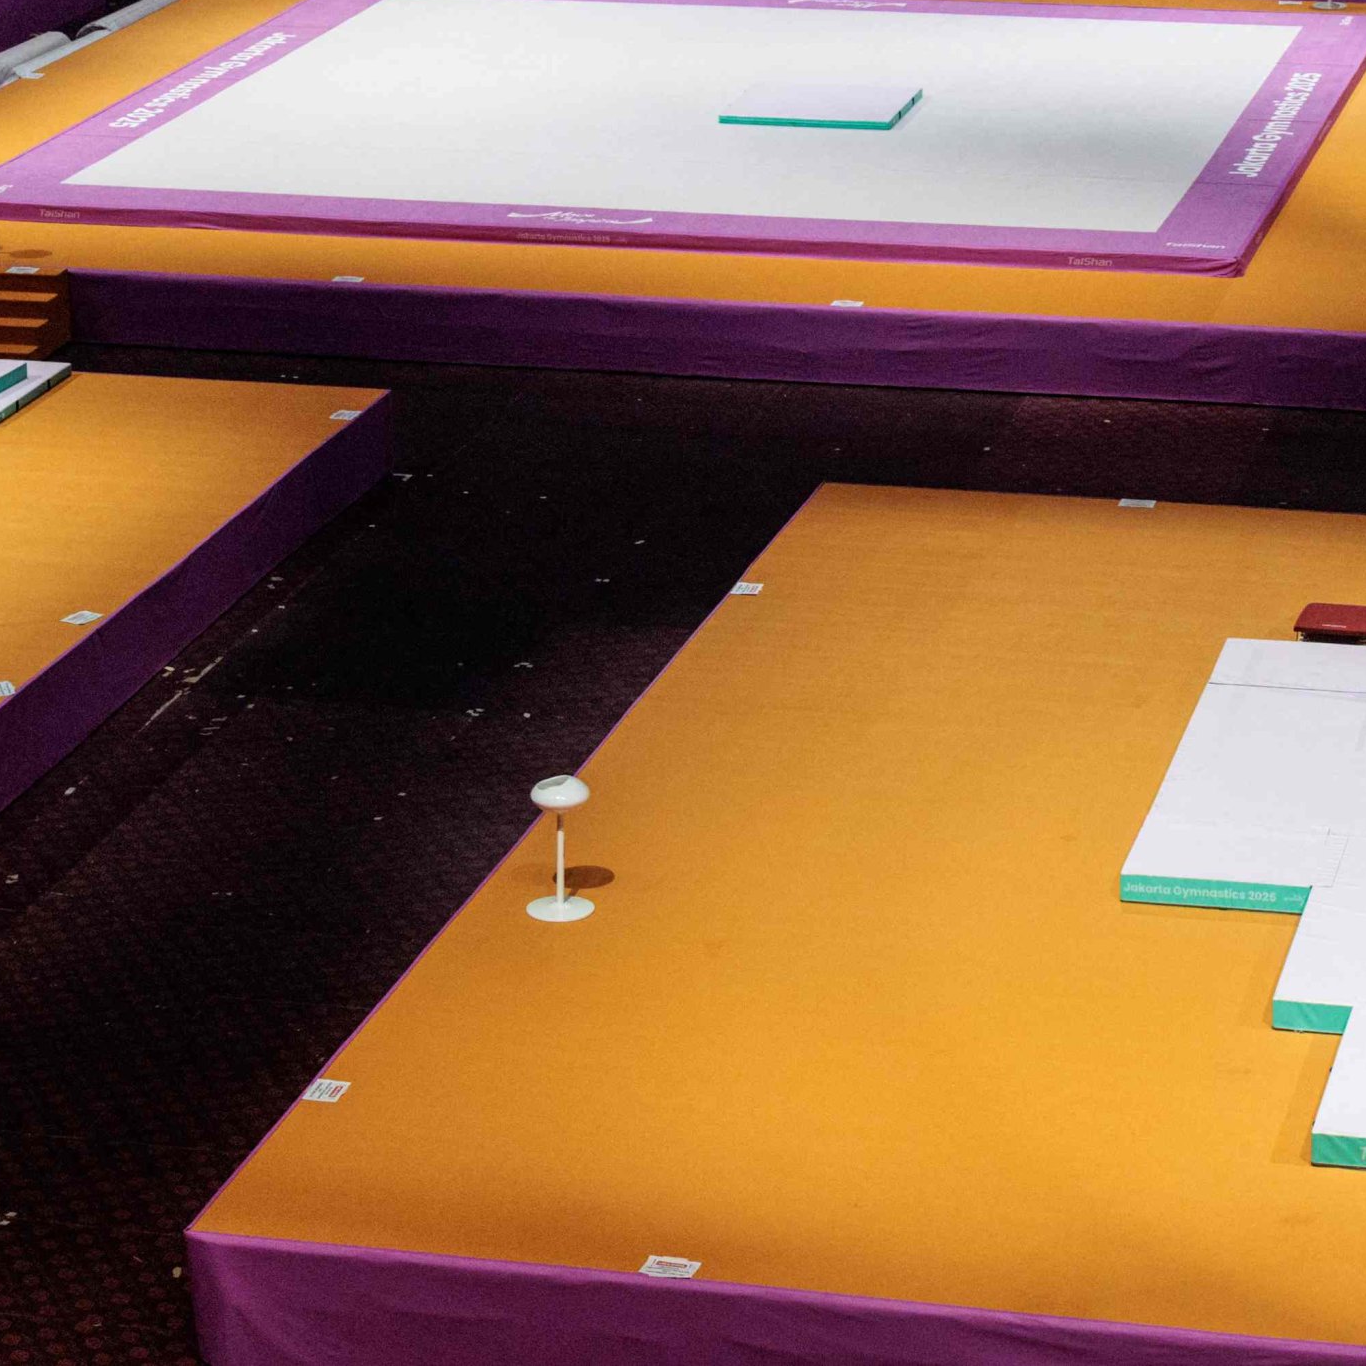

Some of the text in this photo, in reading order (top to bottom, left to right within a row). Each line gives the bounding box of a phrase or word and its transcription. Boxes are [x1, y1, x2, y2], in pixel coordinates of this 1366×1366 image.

[108, 32, 296, 128] Jakarta Gymnastics 2025
[1228, 72, 1322, 177] Jakarta Gymnastics 2025
[1068, 256, 1113, 267] TaiShan
[1123, 882, 1277, 903] Jakarta Gymnastics 2025
